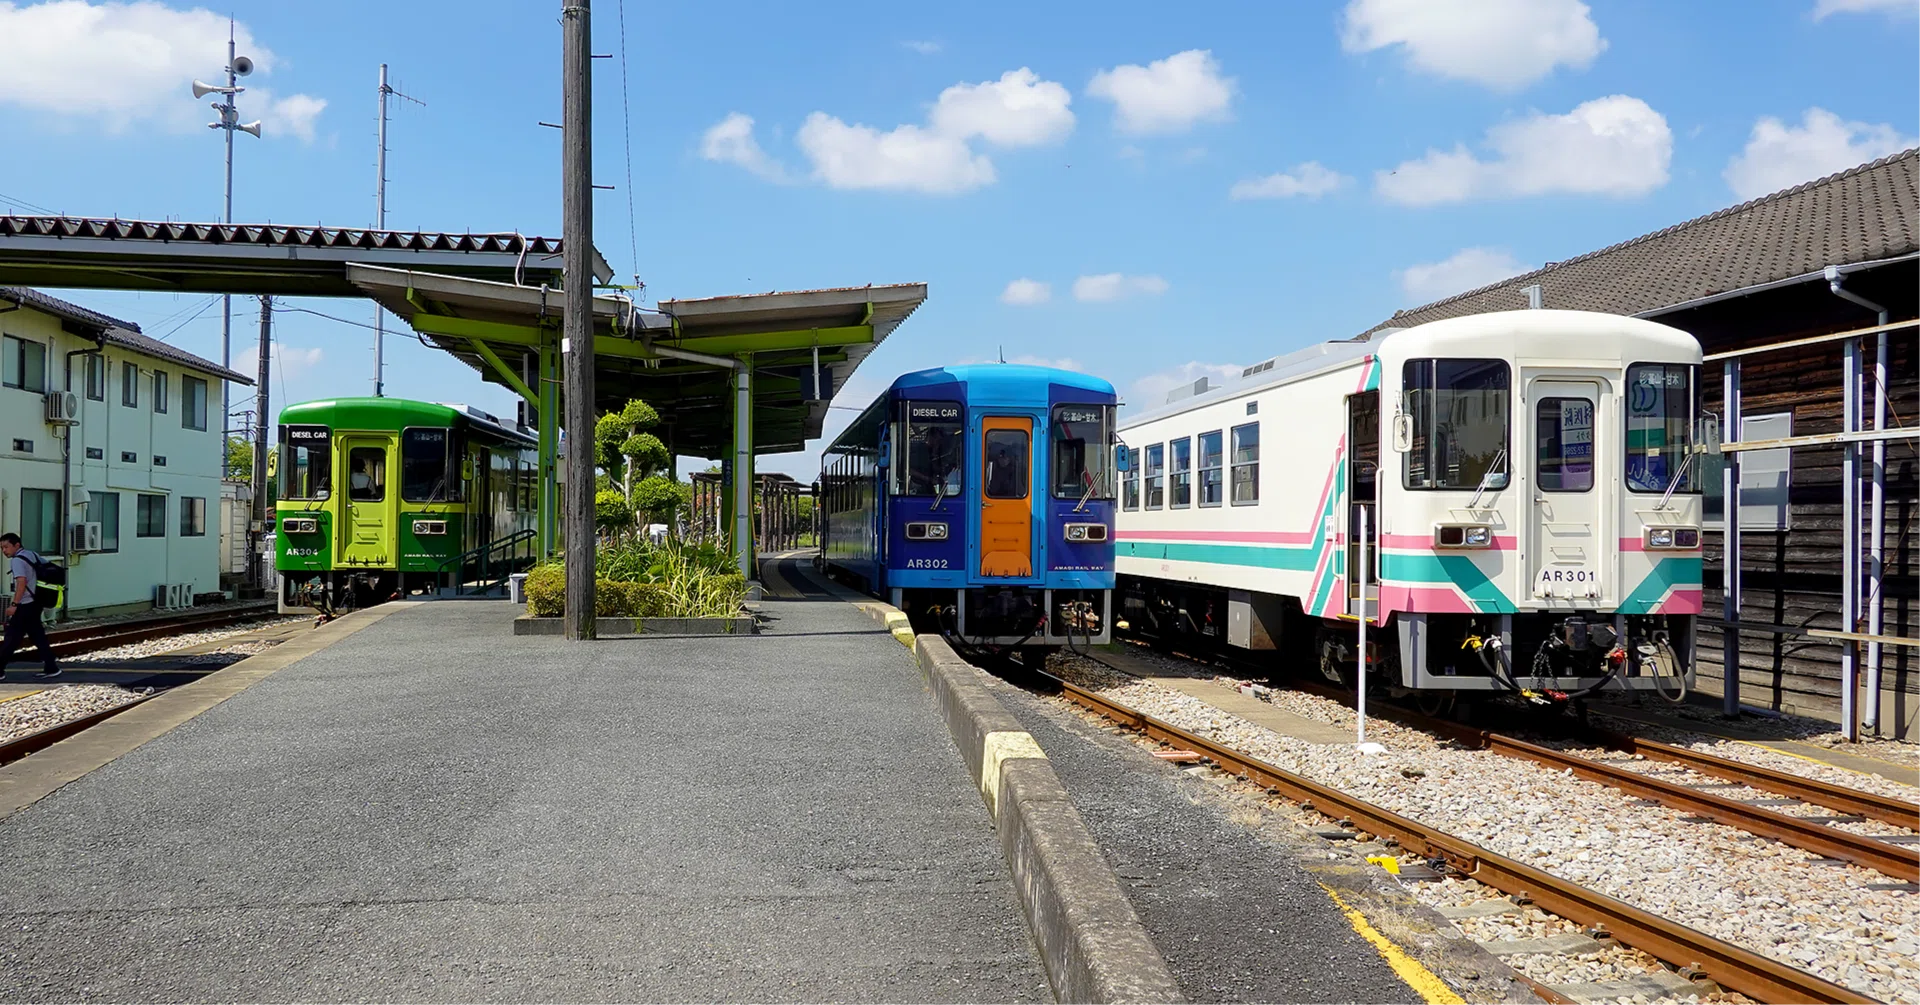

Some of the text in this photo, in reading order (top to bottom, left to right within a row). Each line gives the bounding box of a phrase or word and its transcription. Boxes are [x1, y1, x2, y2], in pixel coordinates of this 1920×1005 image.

[913, 409, 957, 417] DIESEL CAR
[291, 431, 327, 439] DIESEL CAR
[286, 548, 318, 556] AR304
[907, 559, 948, 569] AR302
[1542, 570, 1594, 582] AR301
